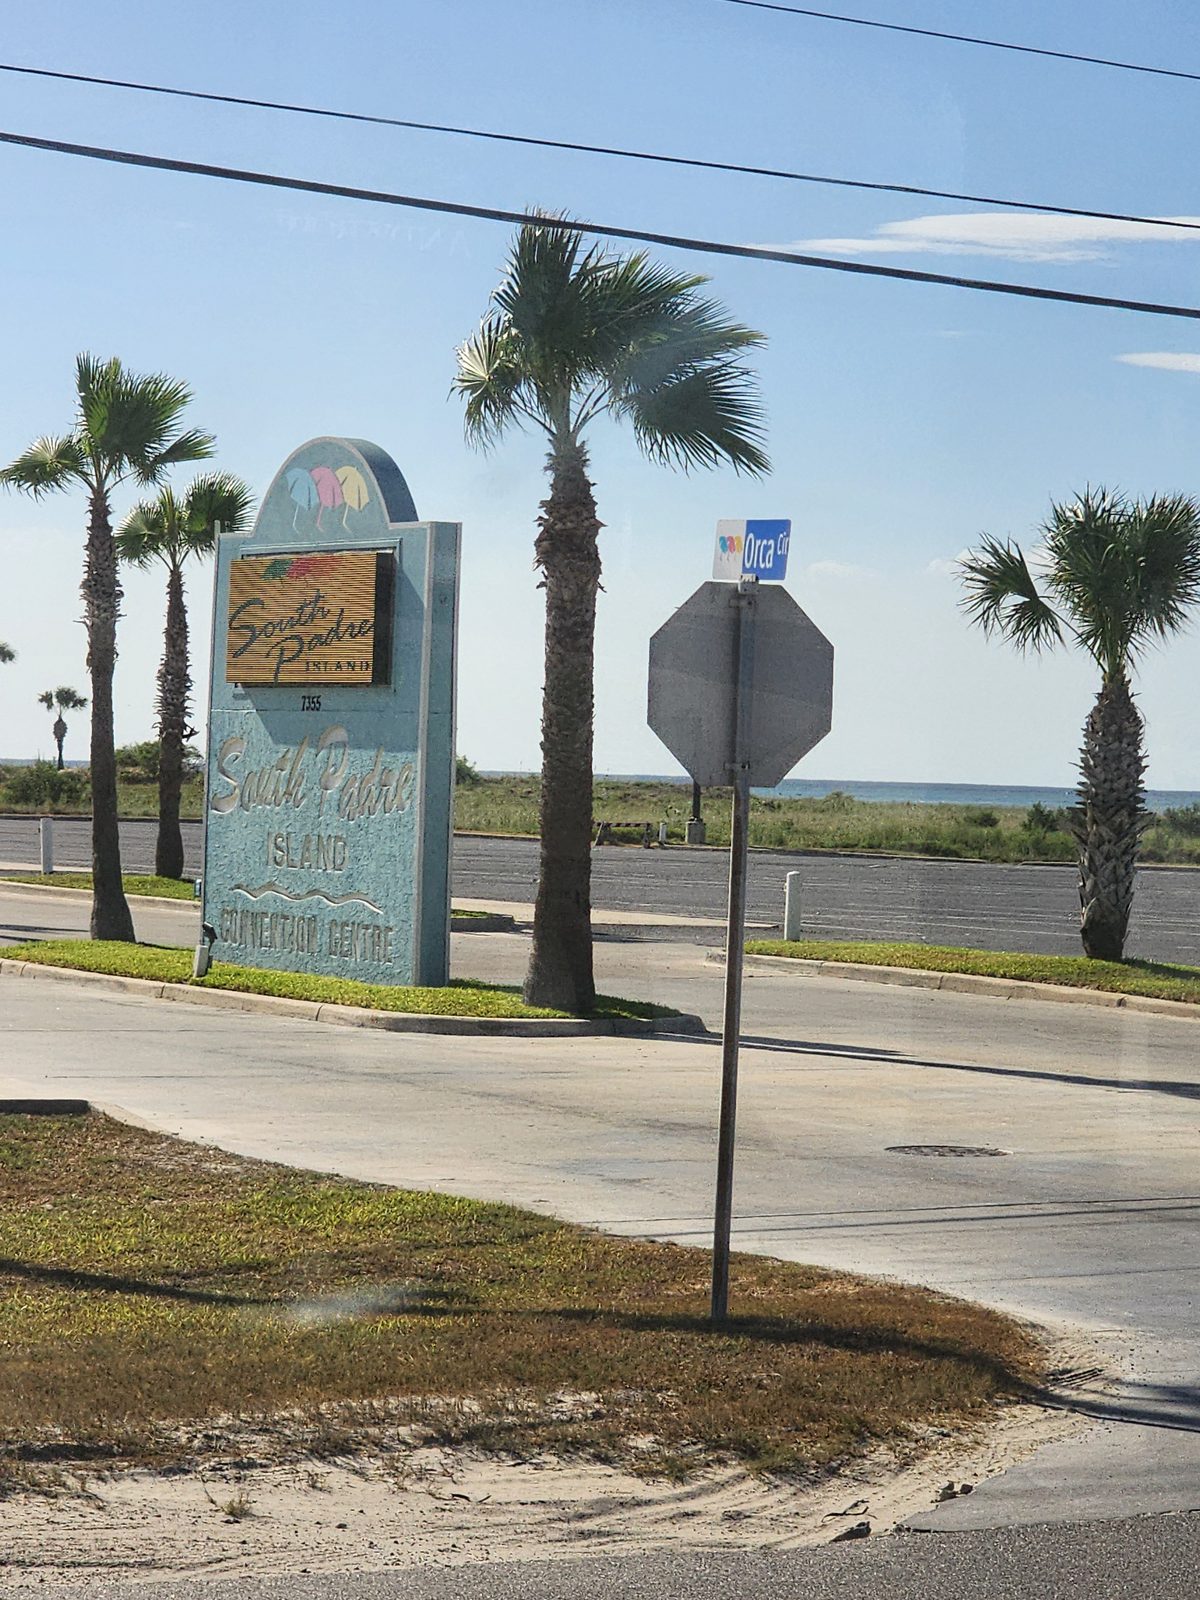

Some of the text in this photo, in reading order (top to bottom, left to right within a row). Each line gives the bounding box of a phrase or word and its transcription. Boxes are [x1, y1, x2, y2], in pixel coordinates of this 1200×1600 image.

[744, 532, 775, 569] Orca
[228, 588, 330, 659] South
[265, 607, 376, 687] Padre
[305, 660, 372, 671] ISLAND
[301, 695, 322, 711] 7355
[211, 724, 414, 823] South Padre
[266, 830, 348, 873] ISLAND
